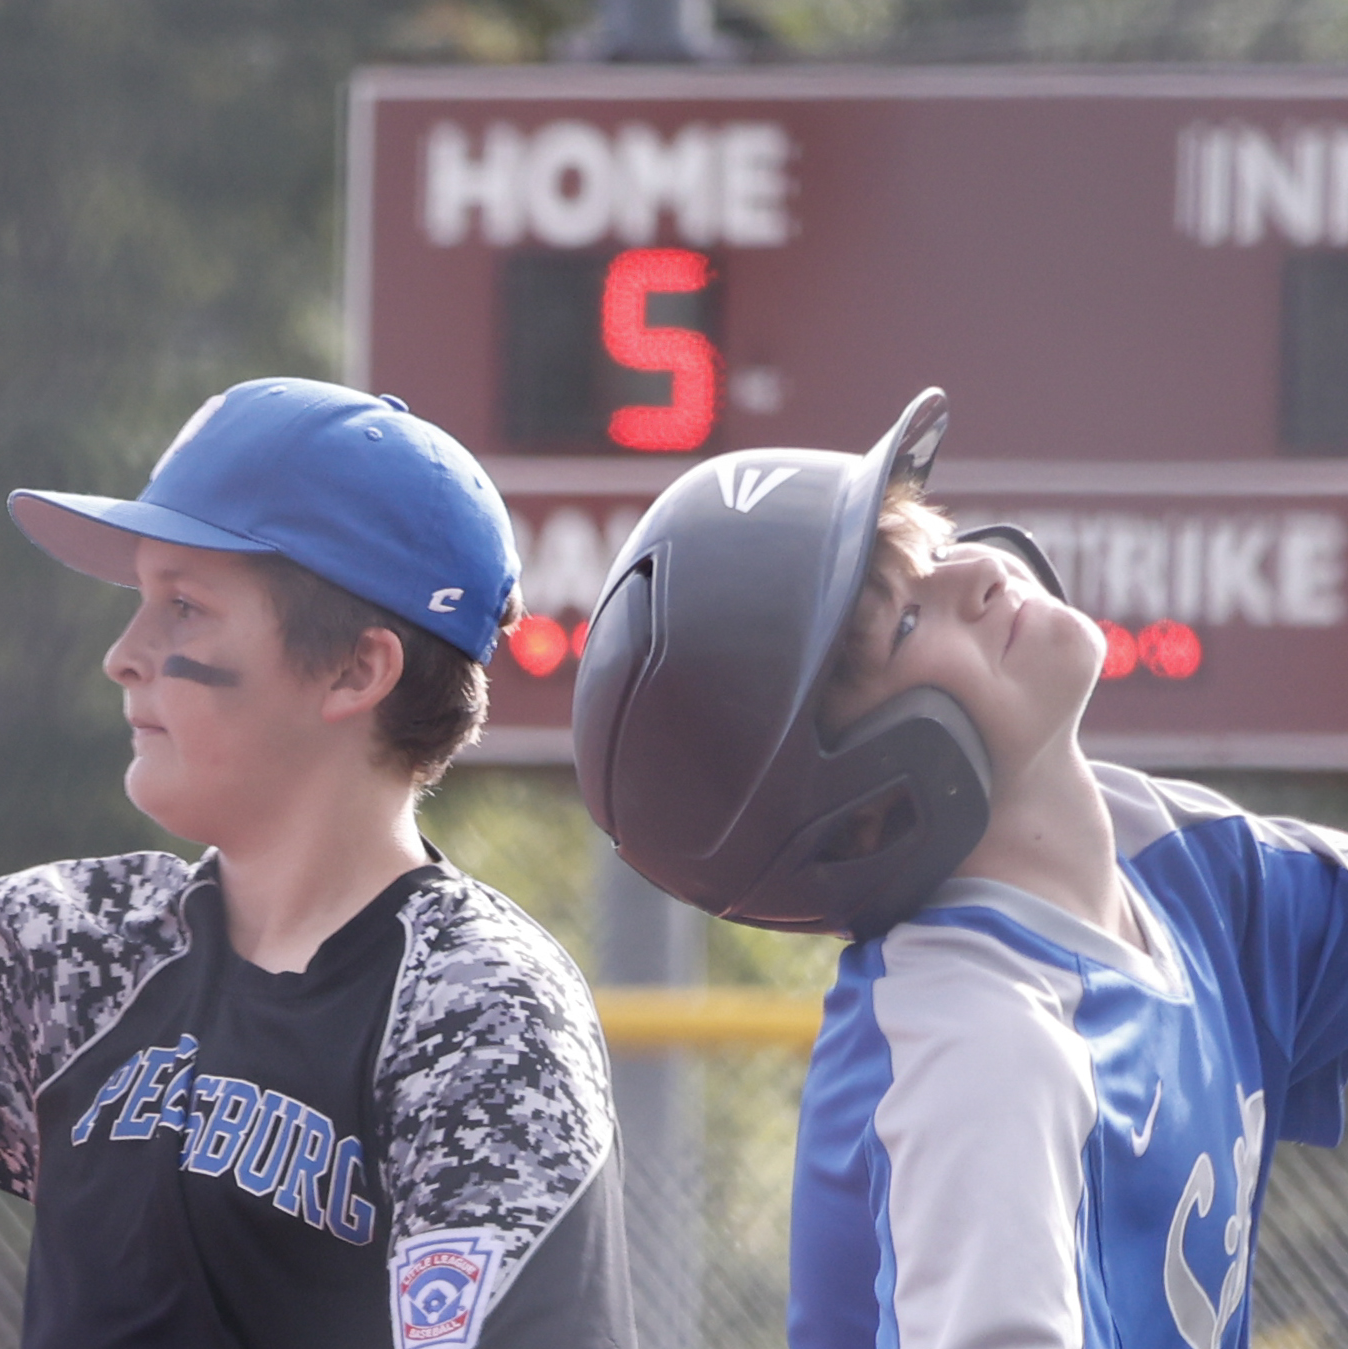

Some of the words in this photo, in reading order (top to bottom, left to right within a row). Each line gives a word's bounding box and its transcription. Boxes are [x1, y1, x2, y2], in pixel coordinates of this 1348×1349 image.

[423, 121, 794, 247] HOME
[602, 247, 719, 452] 5
[963, 508, 1348, 627] TRIKE
